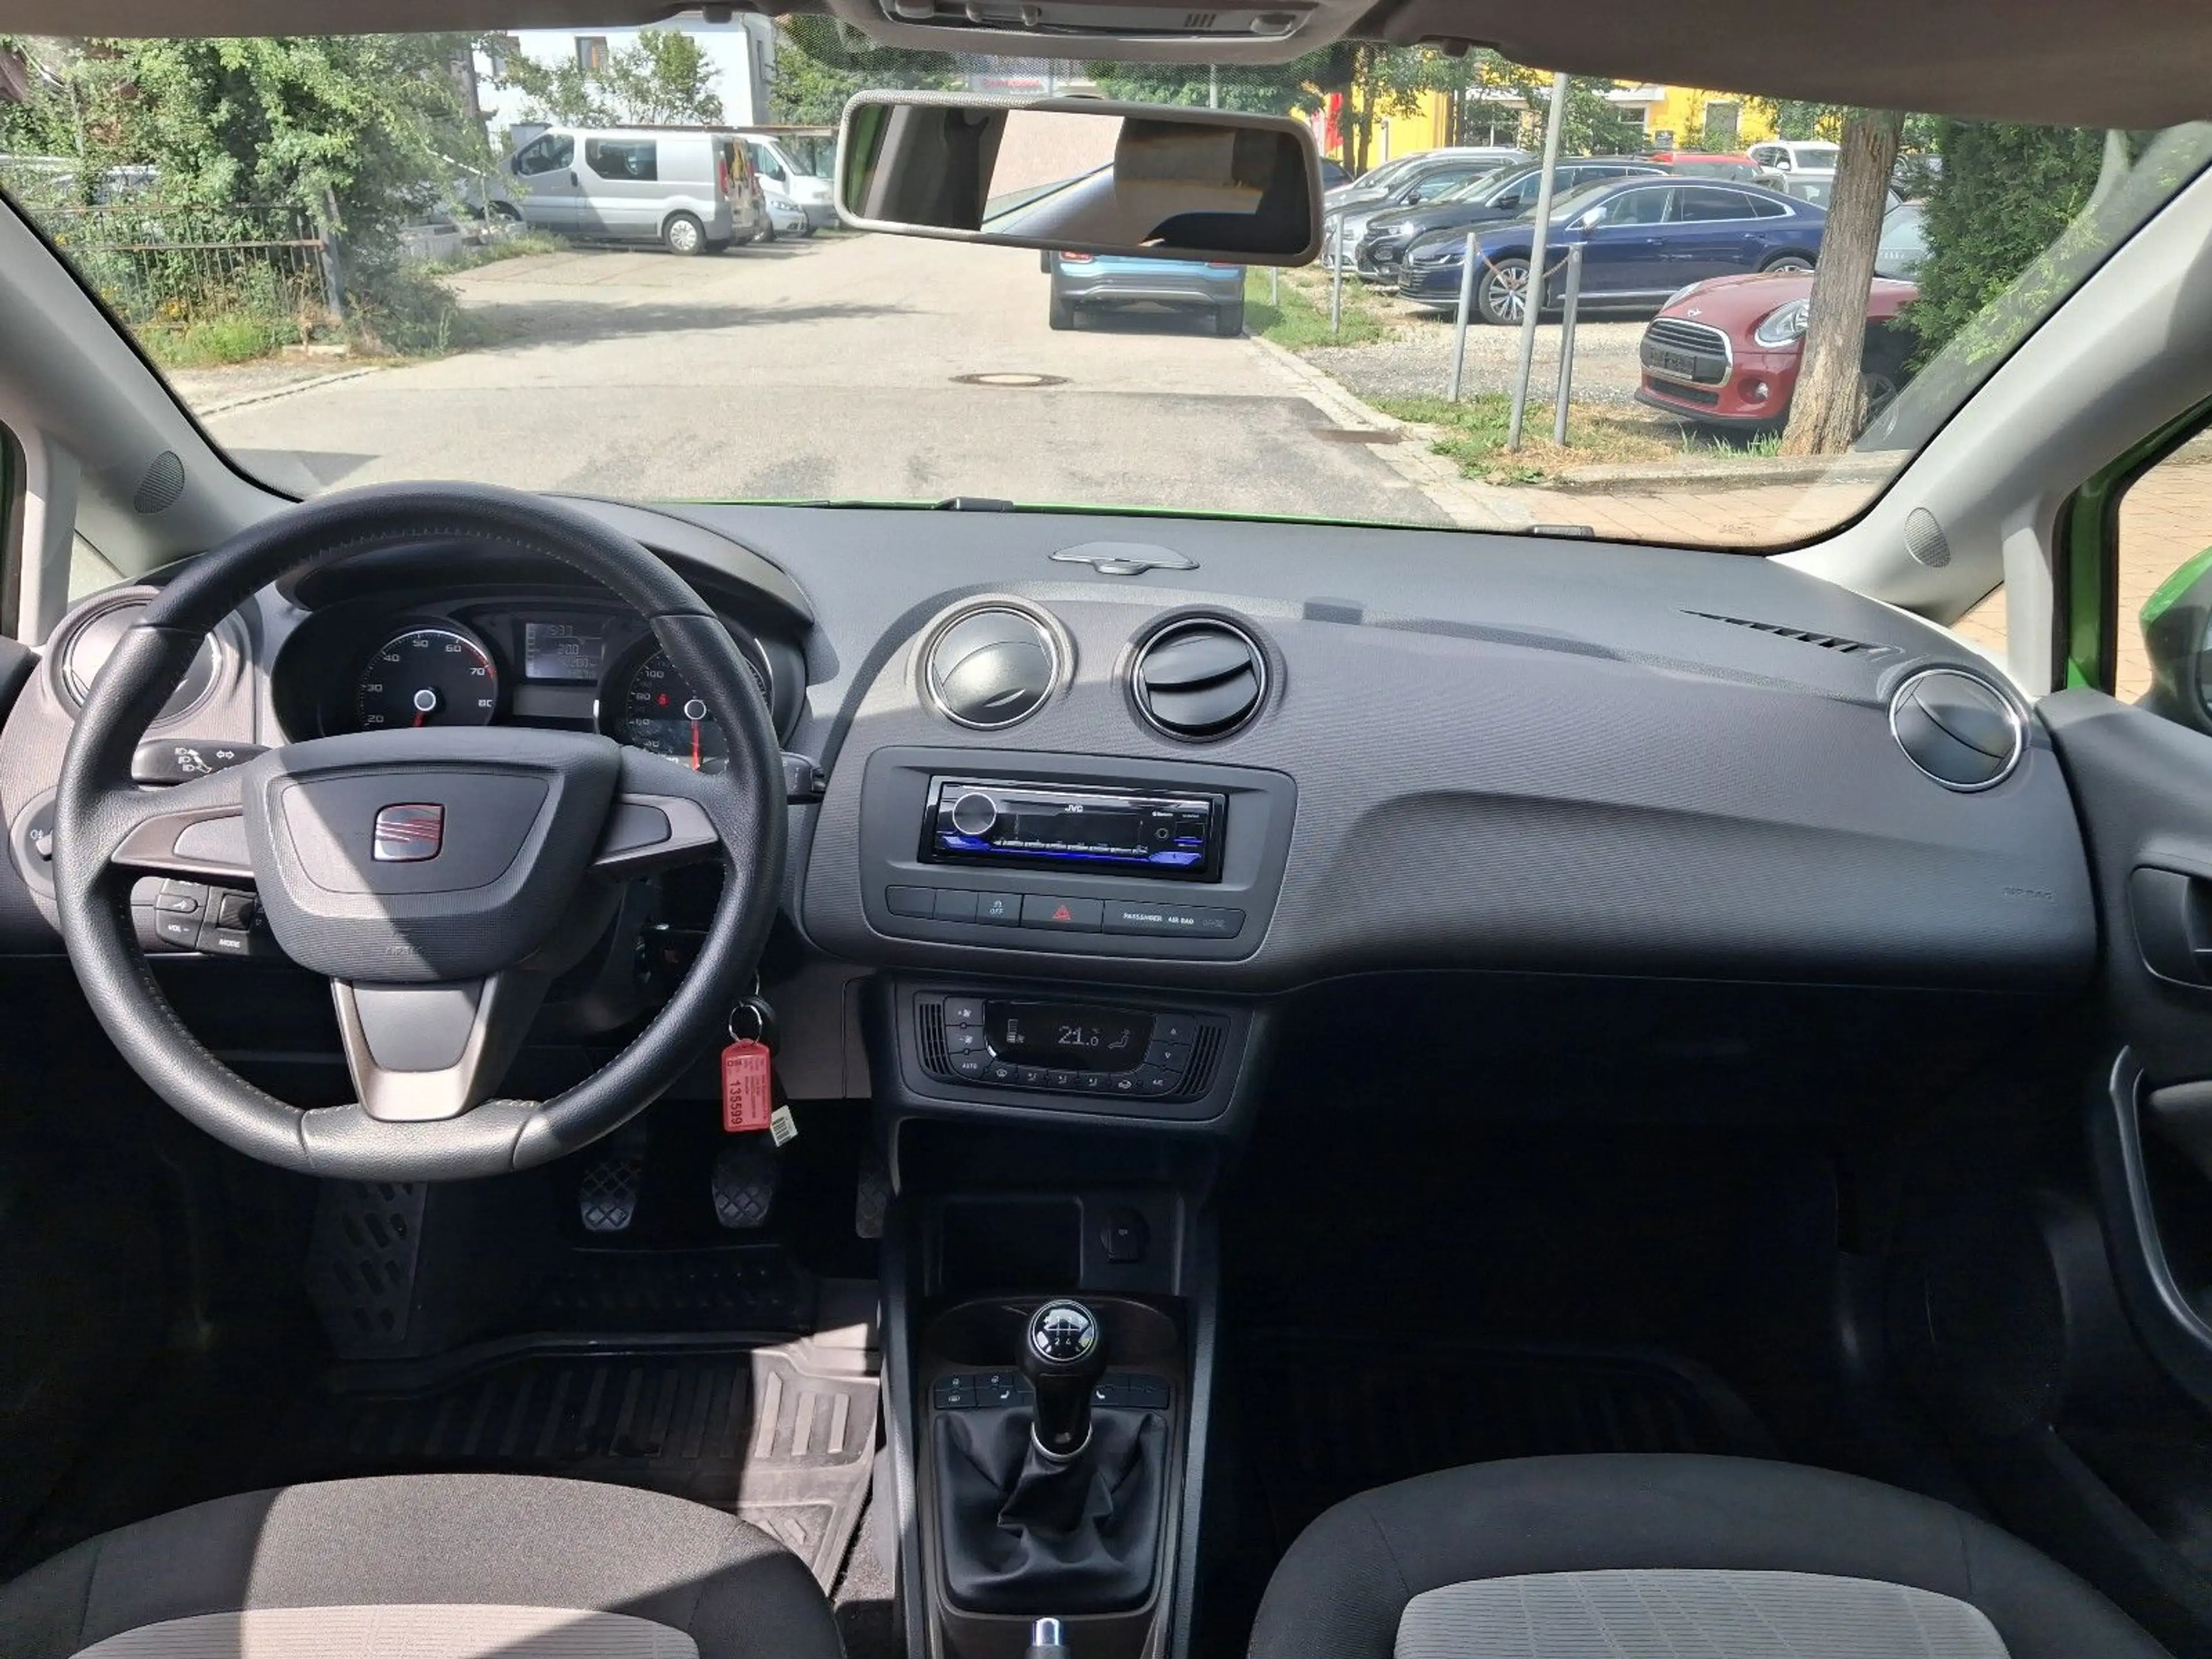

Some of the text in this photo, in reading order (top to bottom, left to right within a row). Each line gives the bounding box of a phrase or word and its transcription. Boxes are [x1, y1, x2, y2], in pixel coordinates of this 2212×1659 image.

[645, 670, 664, 678] 100
[1065, 805, 1084, 813] JVC
[218, 939, 240, 948] MODE
[1055, 1338, 1060, 1346] 2
